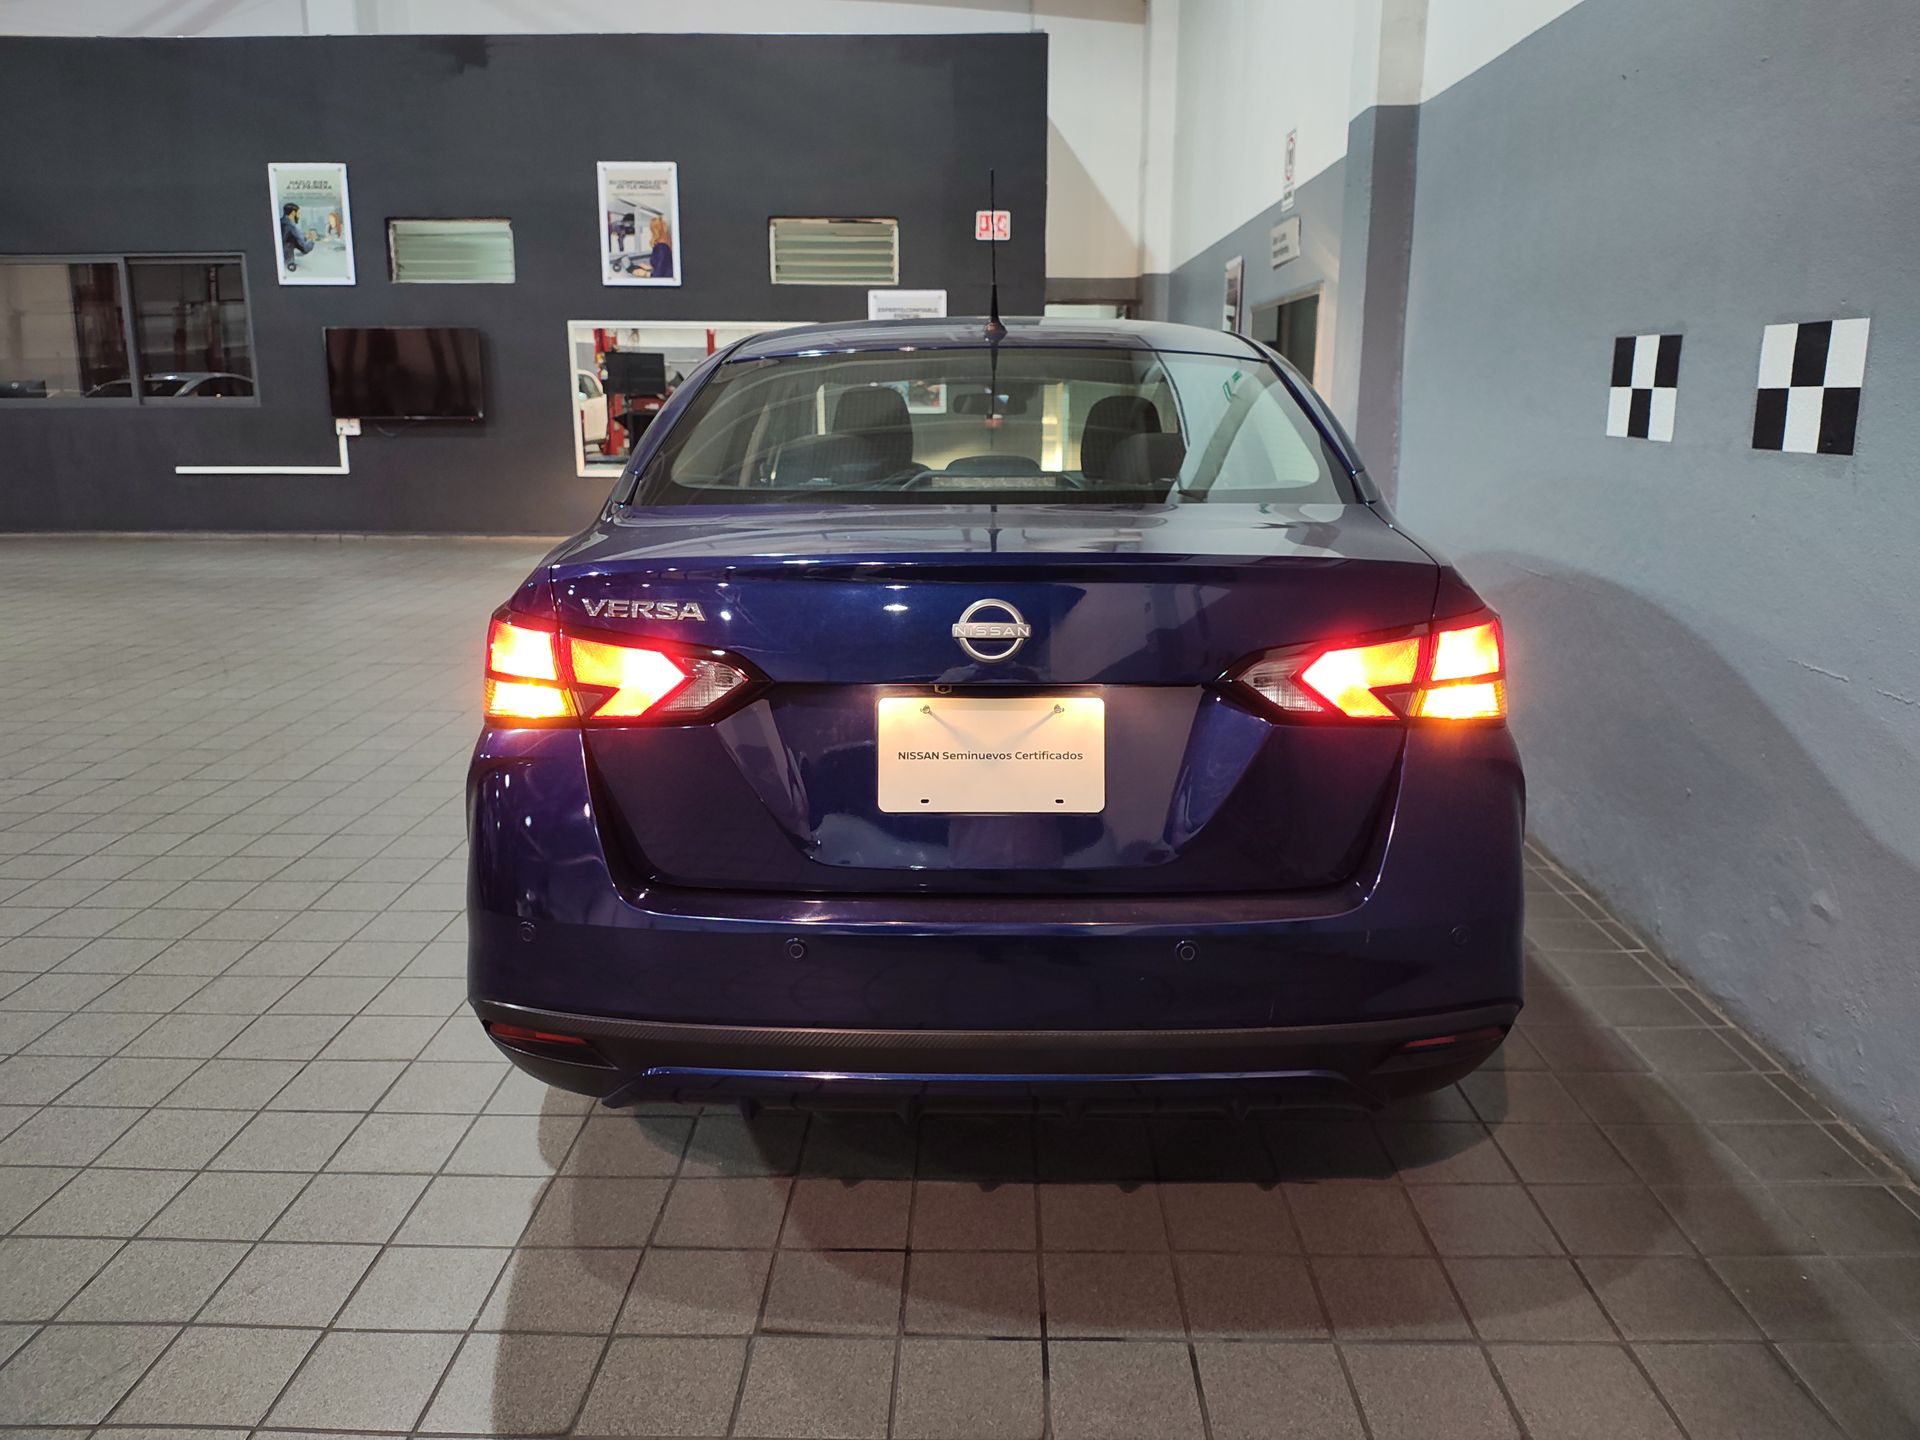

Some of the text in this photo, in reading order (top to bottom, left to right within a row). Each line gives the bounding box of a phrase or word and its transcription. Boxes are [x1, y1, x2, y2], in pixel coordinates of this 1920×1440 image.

[582, 598, 706, 622] VERSA
[955, 626, 1030, 636] NISSAN
[898, 750, 1083, 761] NISSAN Seminuevos Certificados
